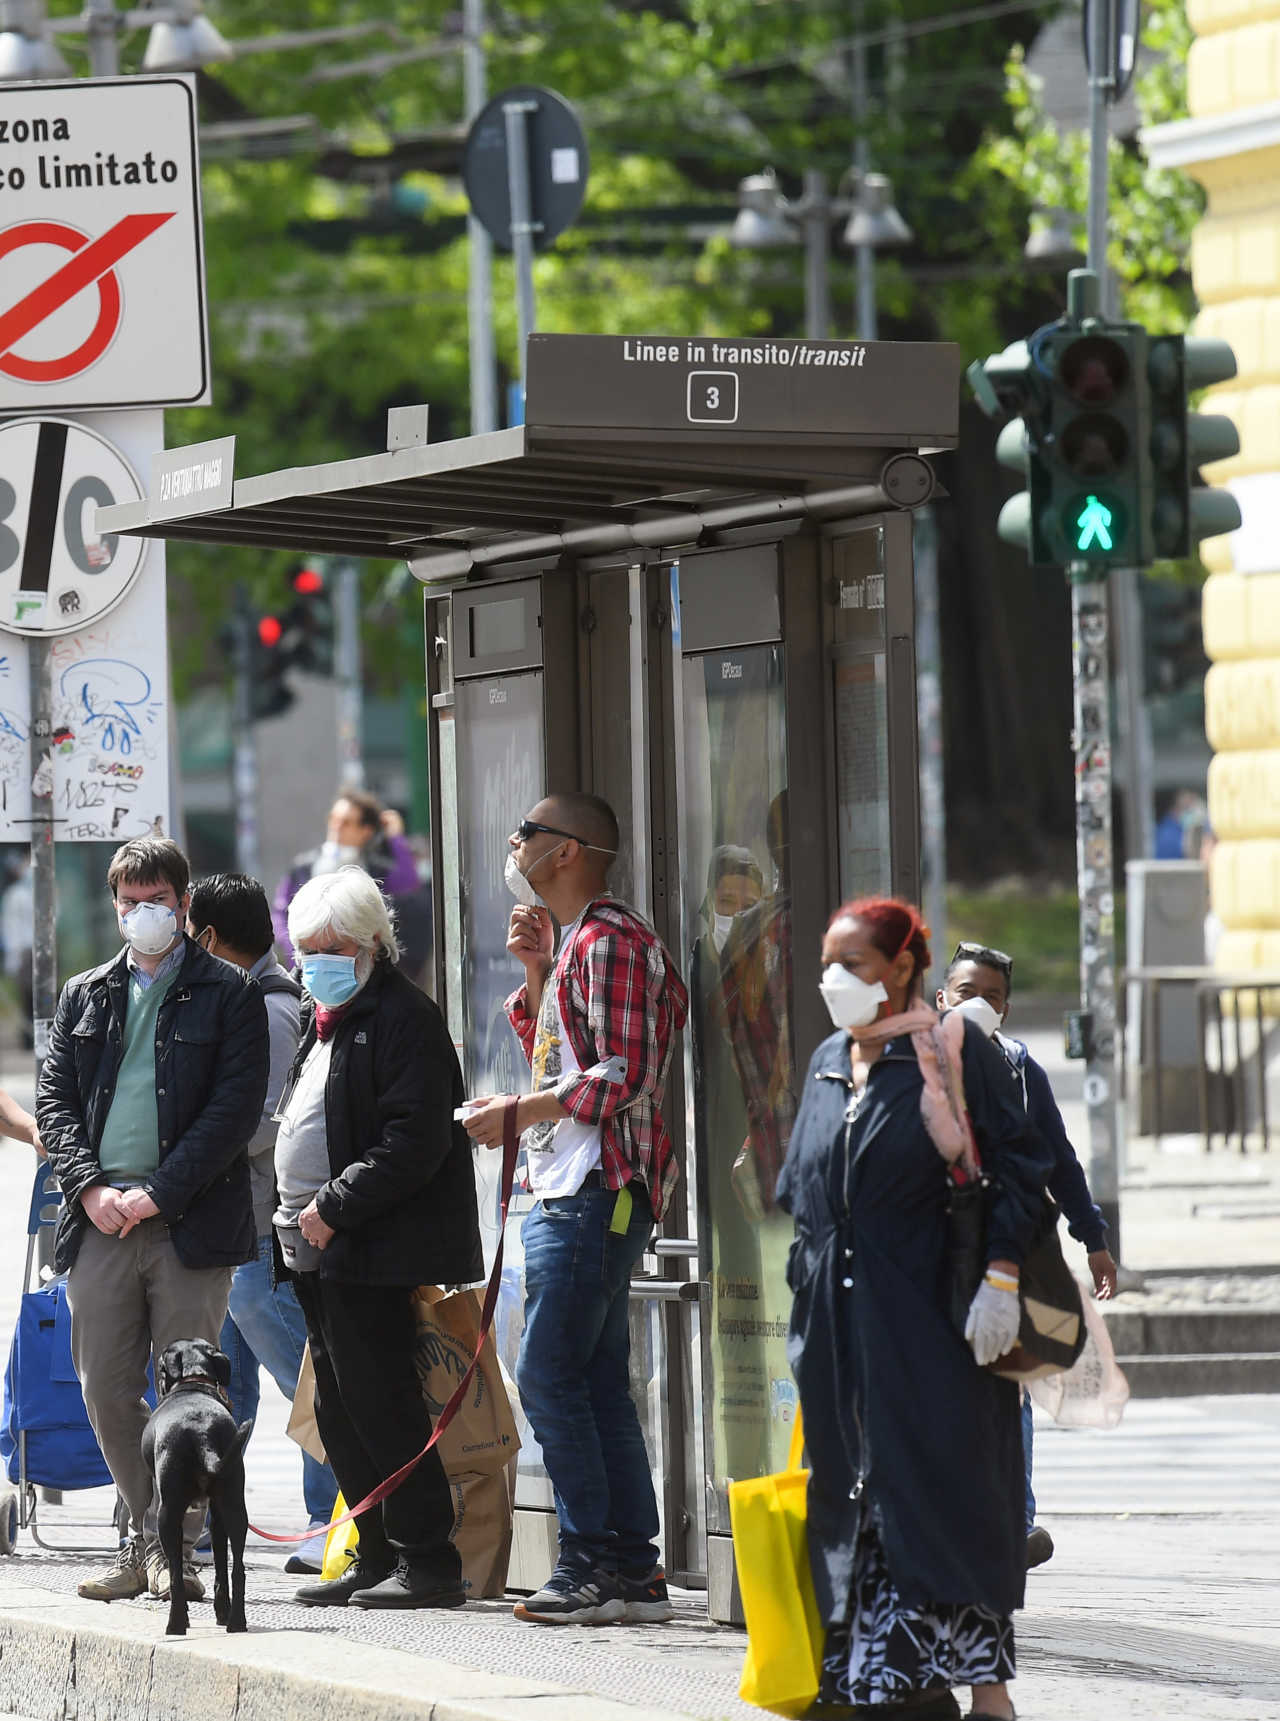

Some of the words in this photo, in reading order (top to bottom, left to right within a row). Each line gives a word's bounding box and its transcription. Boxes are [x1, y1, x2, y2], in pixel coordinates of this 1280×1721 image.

[39, 152, 177, 189] limitato
[623, 340, 680, 362] Linee
[687, 342, 706, 363] in
[712, 343, 867, 367] transito/transit
[705, 386, 720, 409] 3
